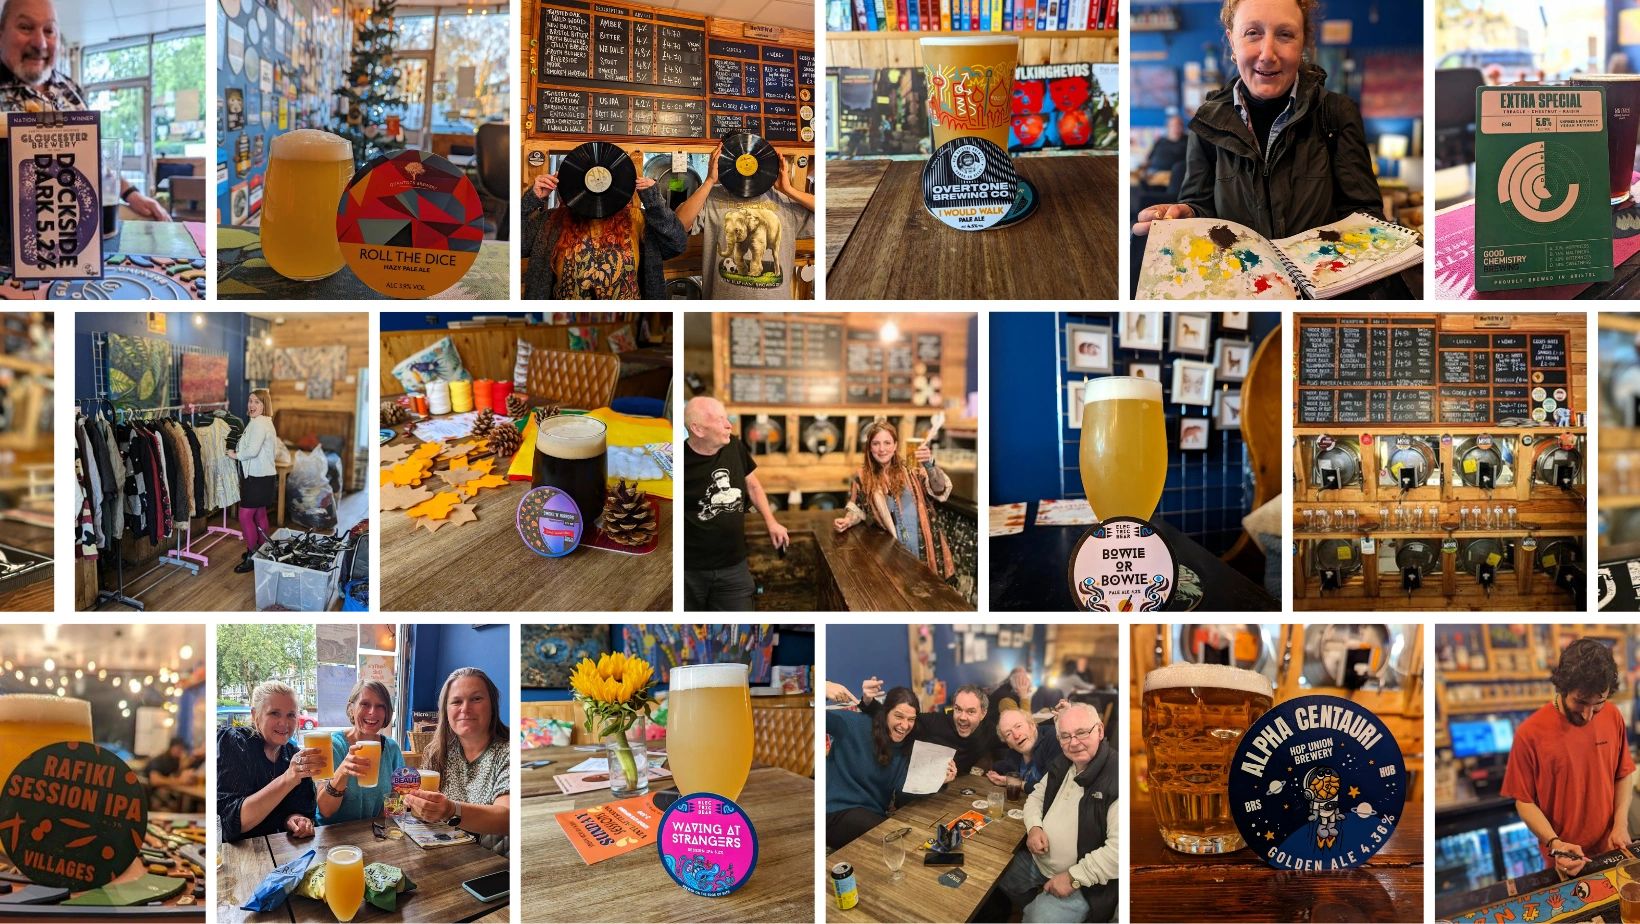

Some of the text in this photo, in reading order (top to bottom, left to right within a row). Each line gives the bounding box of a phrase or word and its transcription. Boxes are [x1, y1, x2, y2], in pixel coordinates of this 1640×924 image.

[600, 18, 623, 30] AMBER
[636, 24, 648, 32] 4%
[600, 31, 621, 41] BITTER
[636, 36, 648, 45] 4%
[600, 57, 618, 66] STOUT
[600, 97, 619, 106] US IPA
[1501, 93, 1582, 108] EXTRA SPECIAL
[600, 123, 615, 132] PALE
[1536, 118, 1552, 126] 5.6%
[20, 132, 89, 143] GLOUCESTER
[31, 141, 77, 149] BREWERY
[34, 154, 54, 213] DARK
[932, 182, 1008, 194] OVERTONE
[932, 191, 988, 201] BREWING
[57, 154, 78, 268] DOCKSIDE
[35, 220, 57, 270] 5.2%
[360, 249, 456, 266] ROLL THE DICE
[1484, 256, 1527, 265] CHEMISTRY
[1484, 264, 1519, 272] BREWING
[1102, 548, 1145, 559] BOWIE
[1116, 561, 1132, 572] OR
[1101, 574, 1148, 586] BOWIE
[1241, 704, 1384, 778] ALPHA CENTAURI
[1289, 737, 1334, 756] HOP UNION
[1294, 747, 1333, 765] BREWERY
[43, 755, 116, 789] RAFIKI
[1379, 764, 1396, 778] HUB
[8, 774, 142, 823] SESSION IPA
[1244, 799, 1262, 813] BRS
[575, 813, 615, 846] SUNDAY
[672, 821, 741, 836] WAVING AT
[672, 833, 741, 848] STRANGERS
[1267, 813, 1395, 872] GOLDEN ALE 4.36%
[24, 849, 96, 883] VILLAGES
